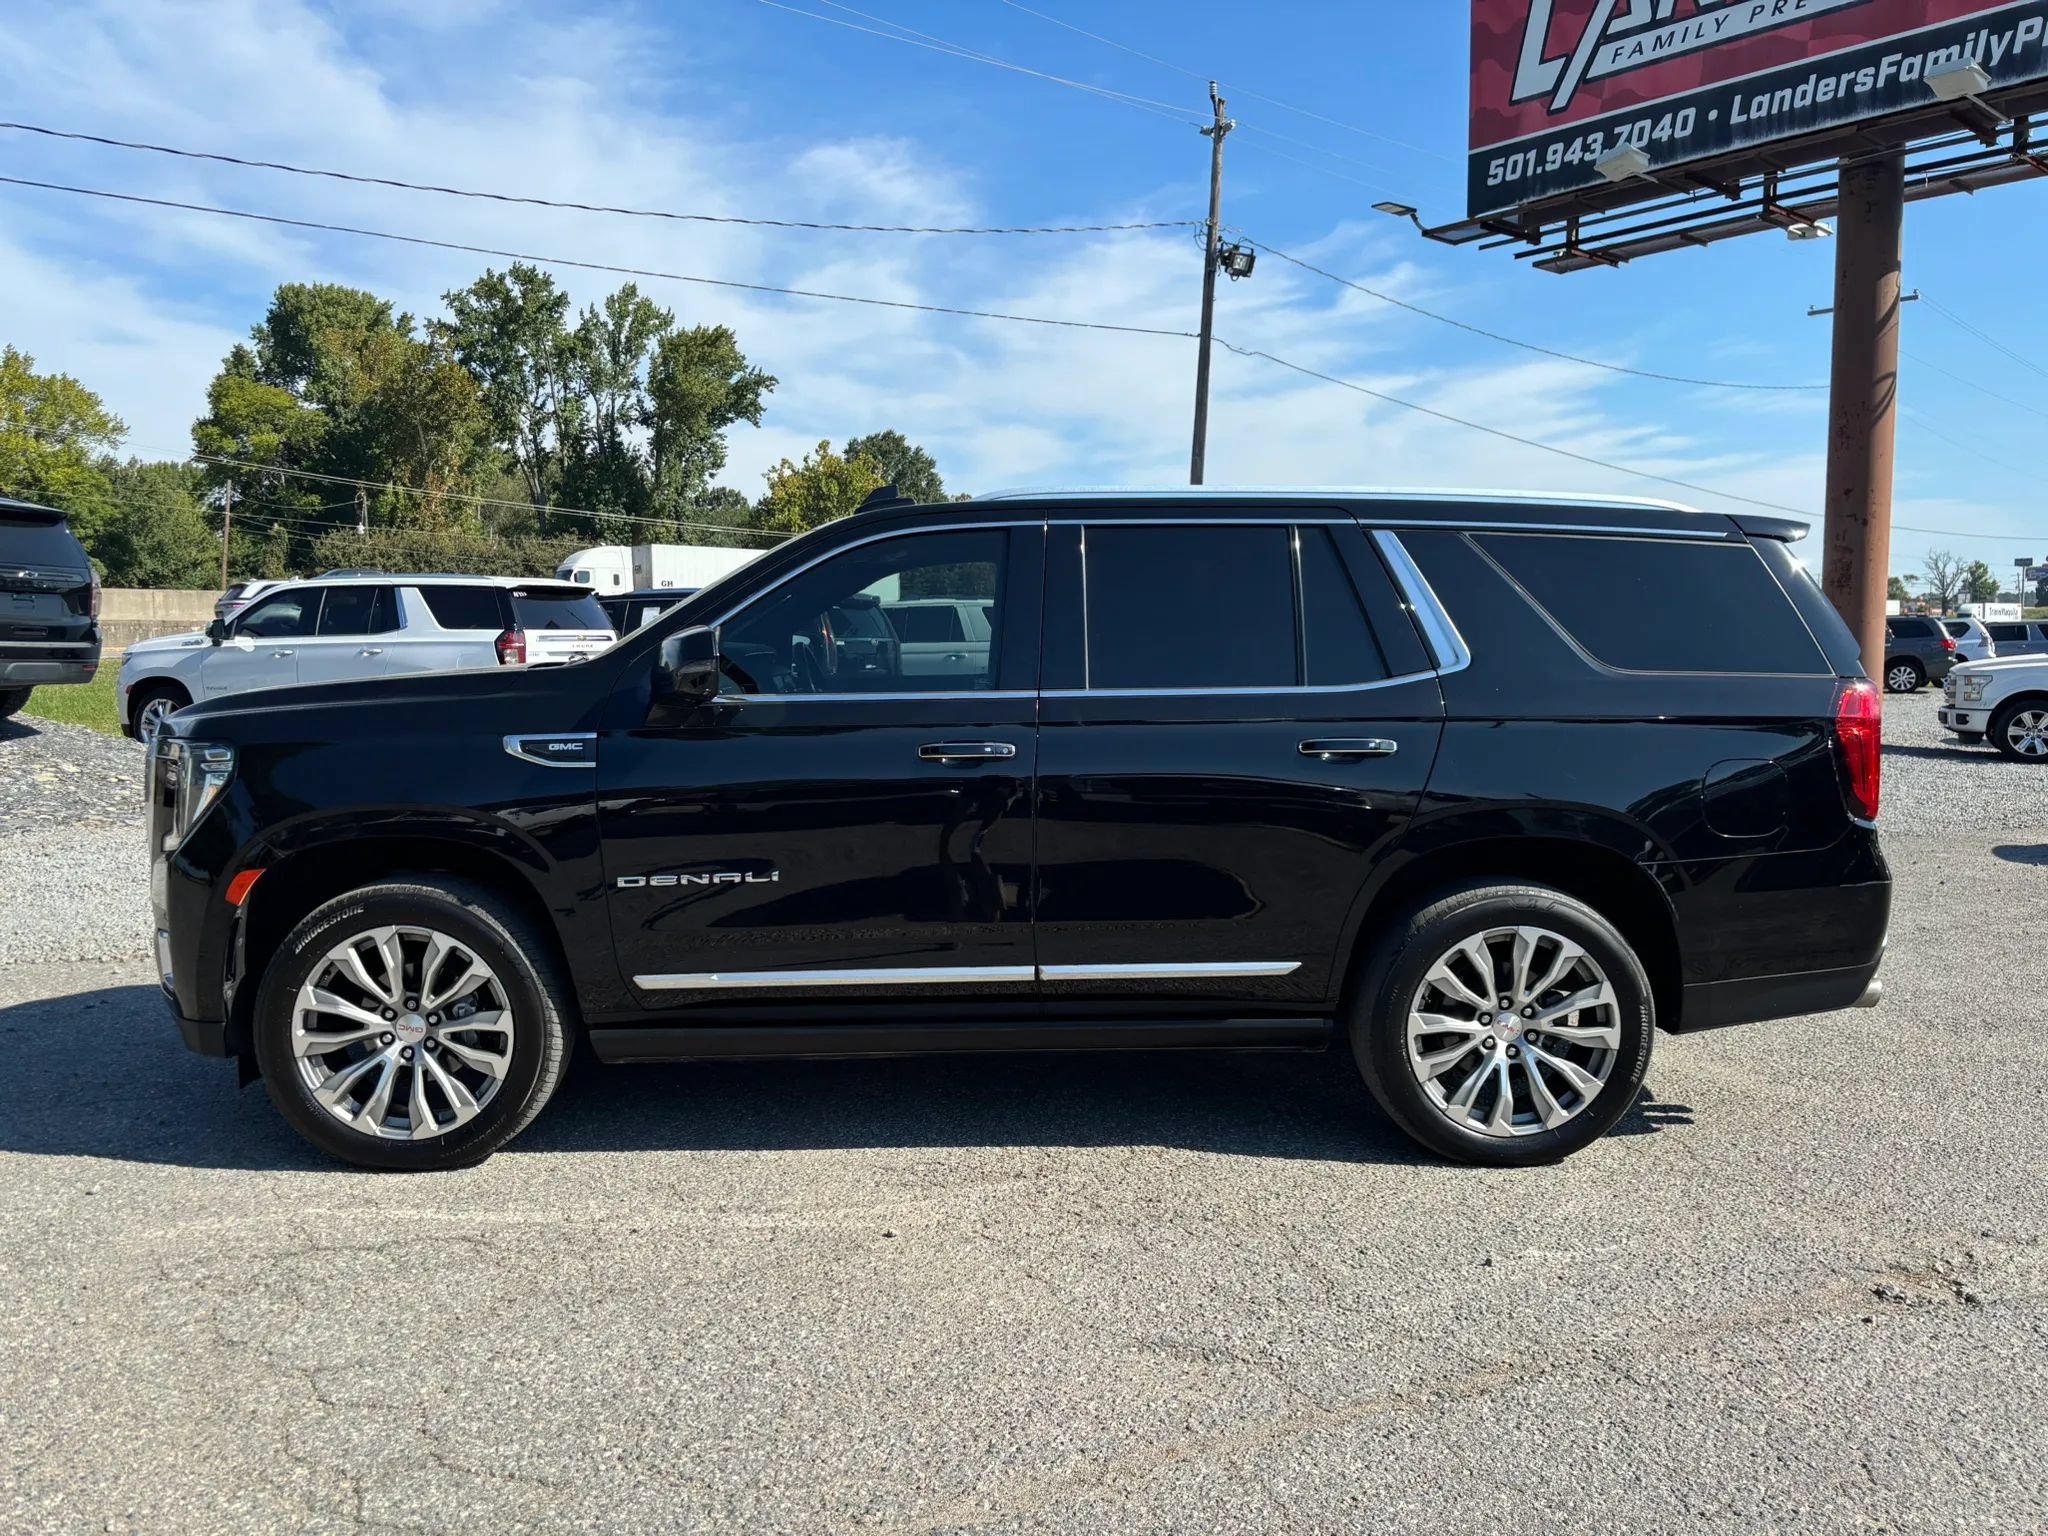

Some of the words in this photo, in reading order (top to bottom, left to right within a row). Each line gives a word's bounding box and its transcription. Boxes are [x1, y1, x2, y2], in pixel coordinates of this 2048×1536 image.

[1610, 14, 1730, 65] FAMILY
[1486, 107, 1697, 186] 501.943.7040
[549, 742, 583, 751] GMC
[617, 870, 780, 888] DENALI
[295, 902, 365, 955] BRIDGESTONE
[399, 1023, 424, 1034] GMC
